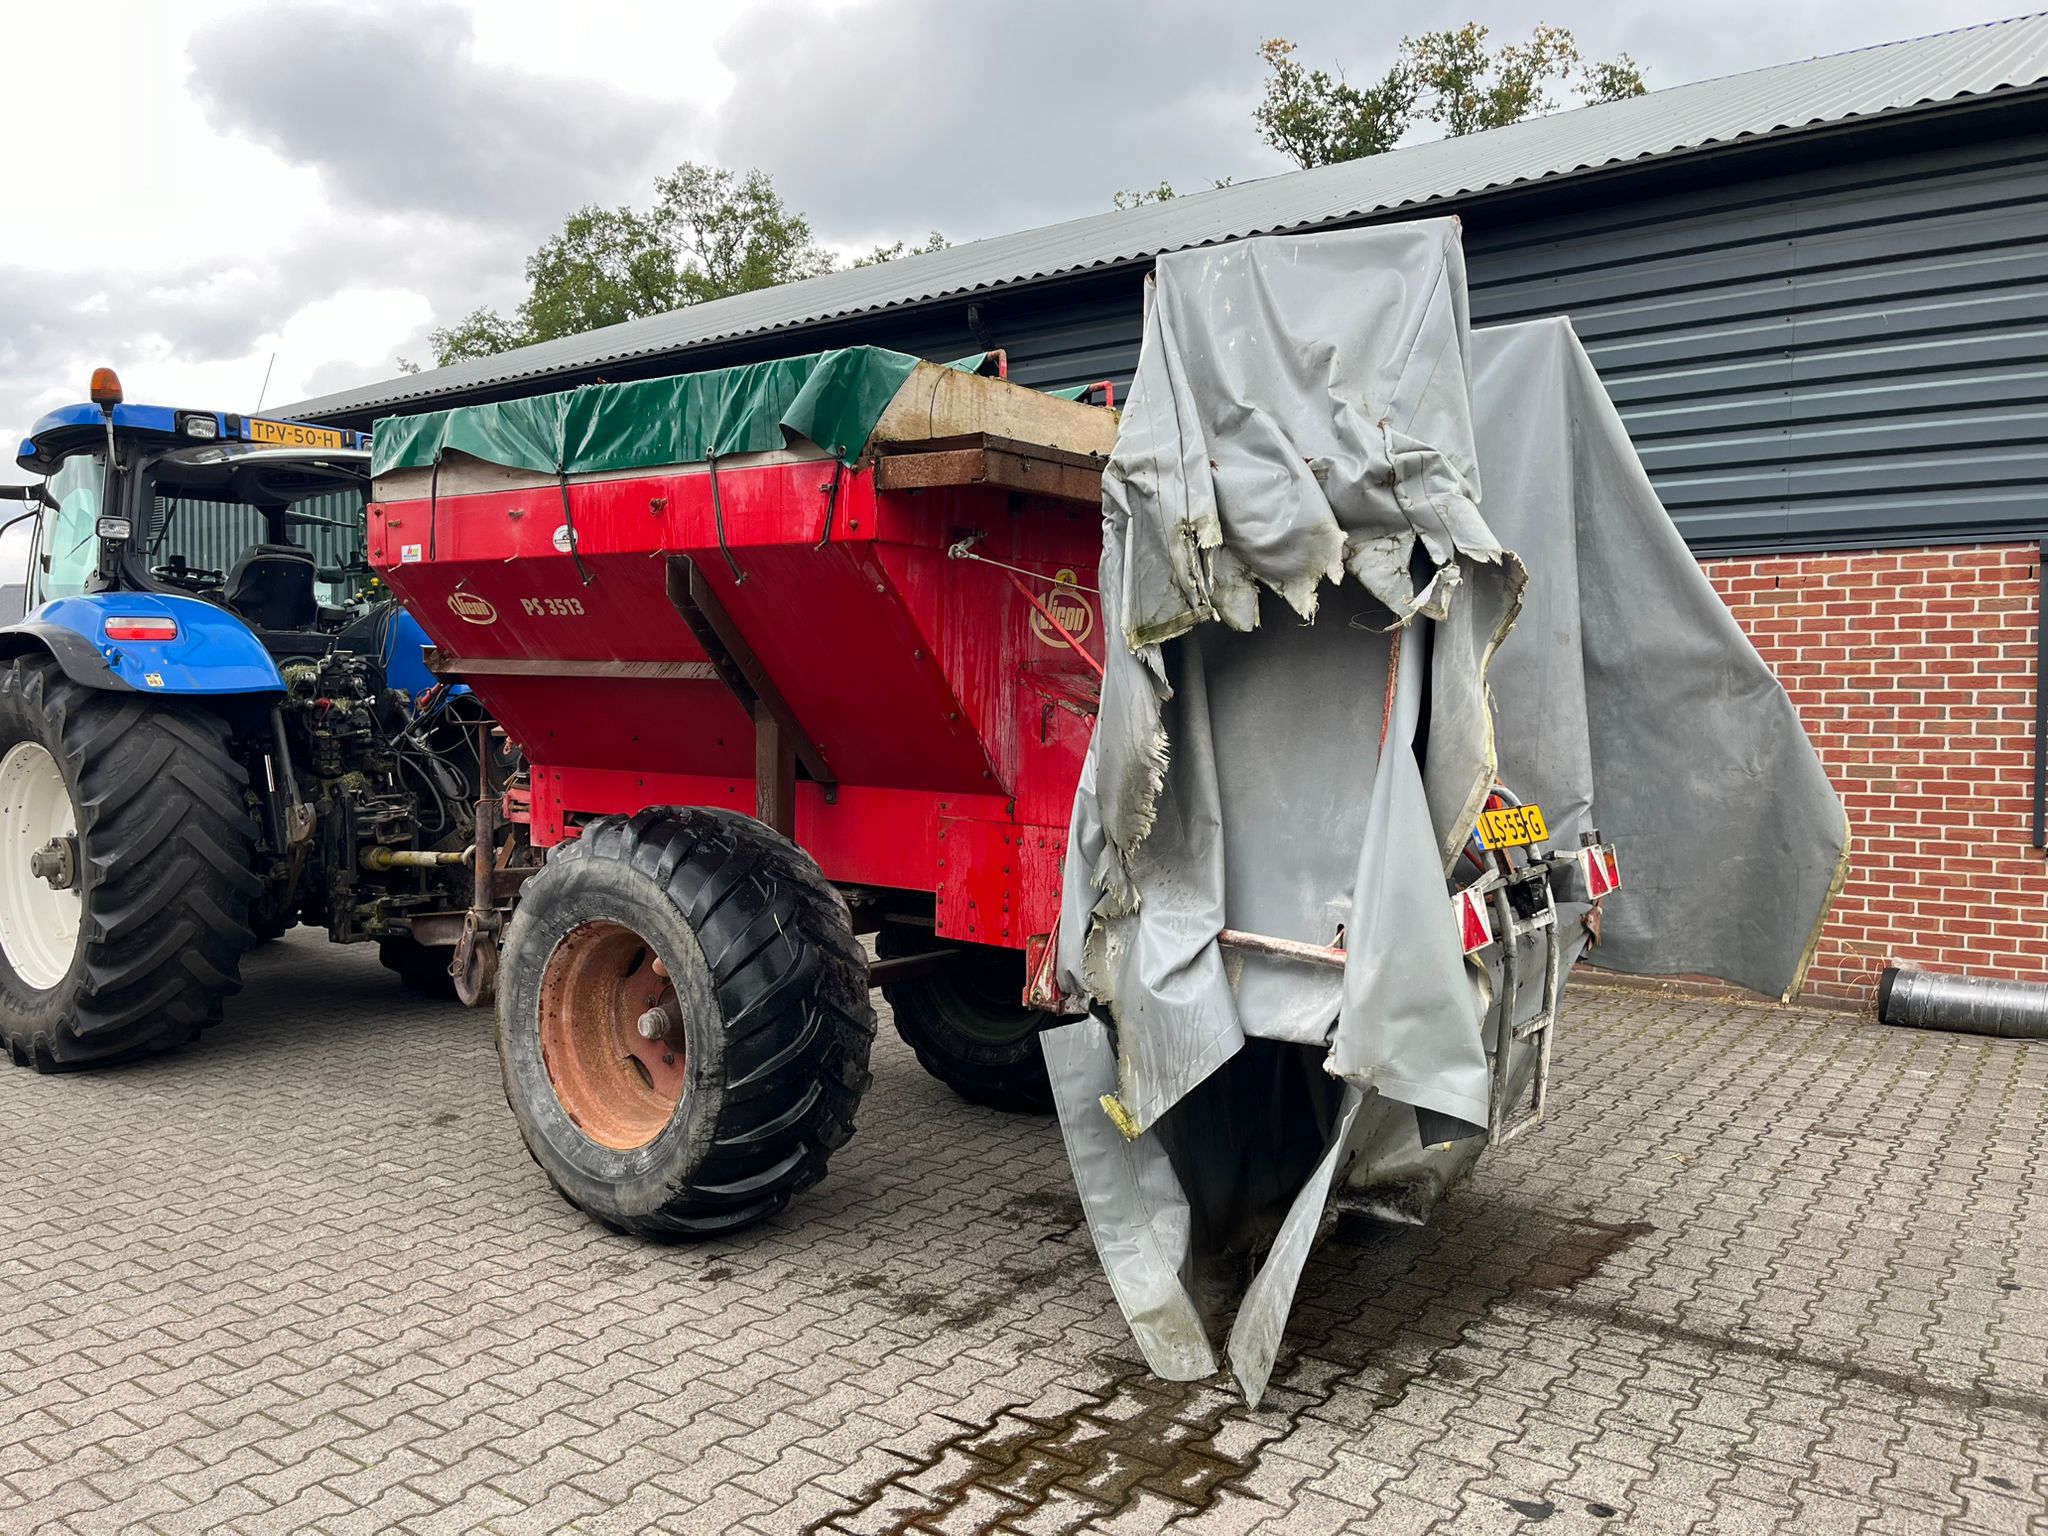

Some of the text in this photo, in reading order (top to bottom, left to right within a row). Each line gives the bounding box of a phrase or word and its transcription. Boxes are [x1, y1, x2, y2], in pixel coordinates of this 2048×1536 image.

[253, 422, 334, 447] TPV-50-H
[447, 592, 491, 616] Vicon
[520, 598, 585, 616] PS 3513
[1479, 810, 1542, 844] LLS-55-G
